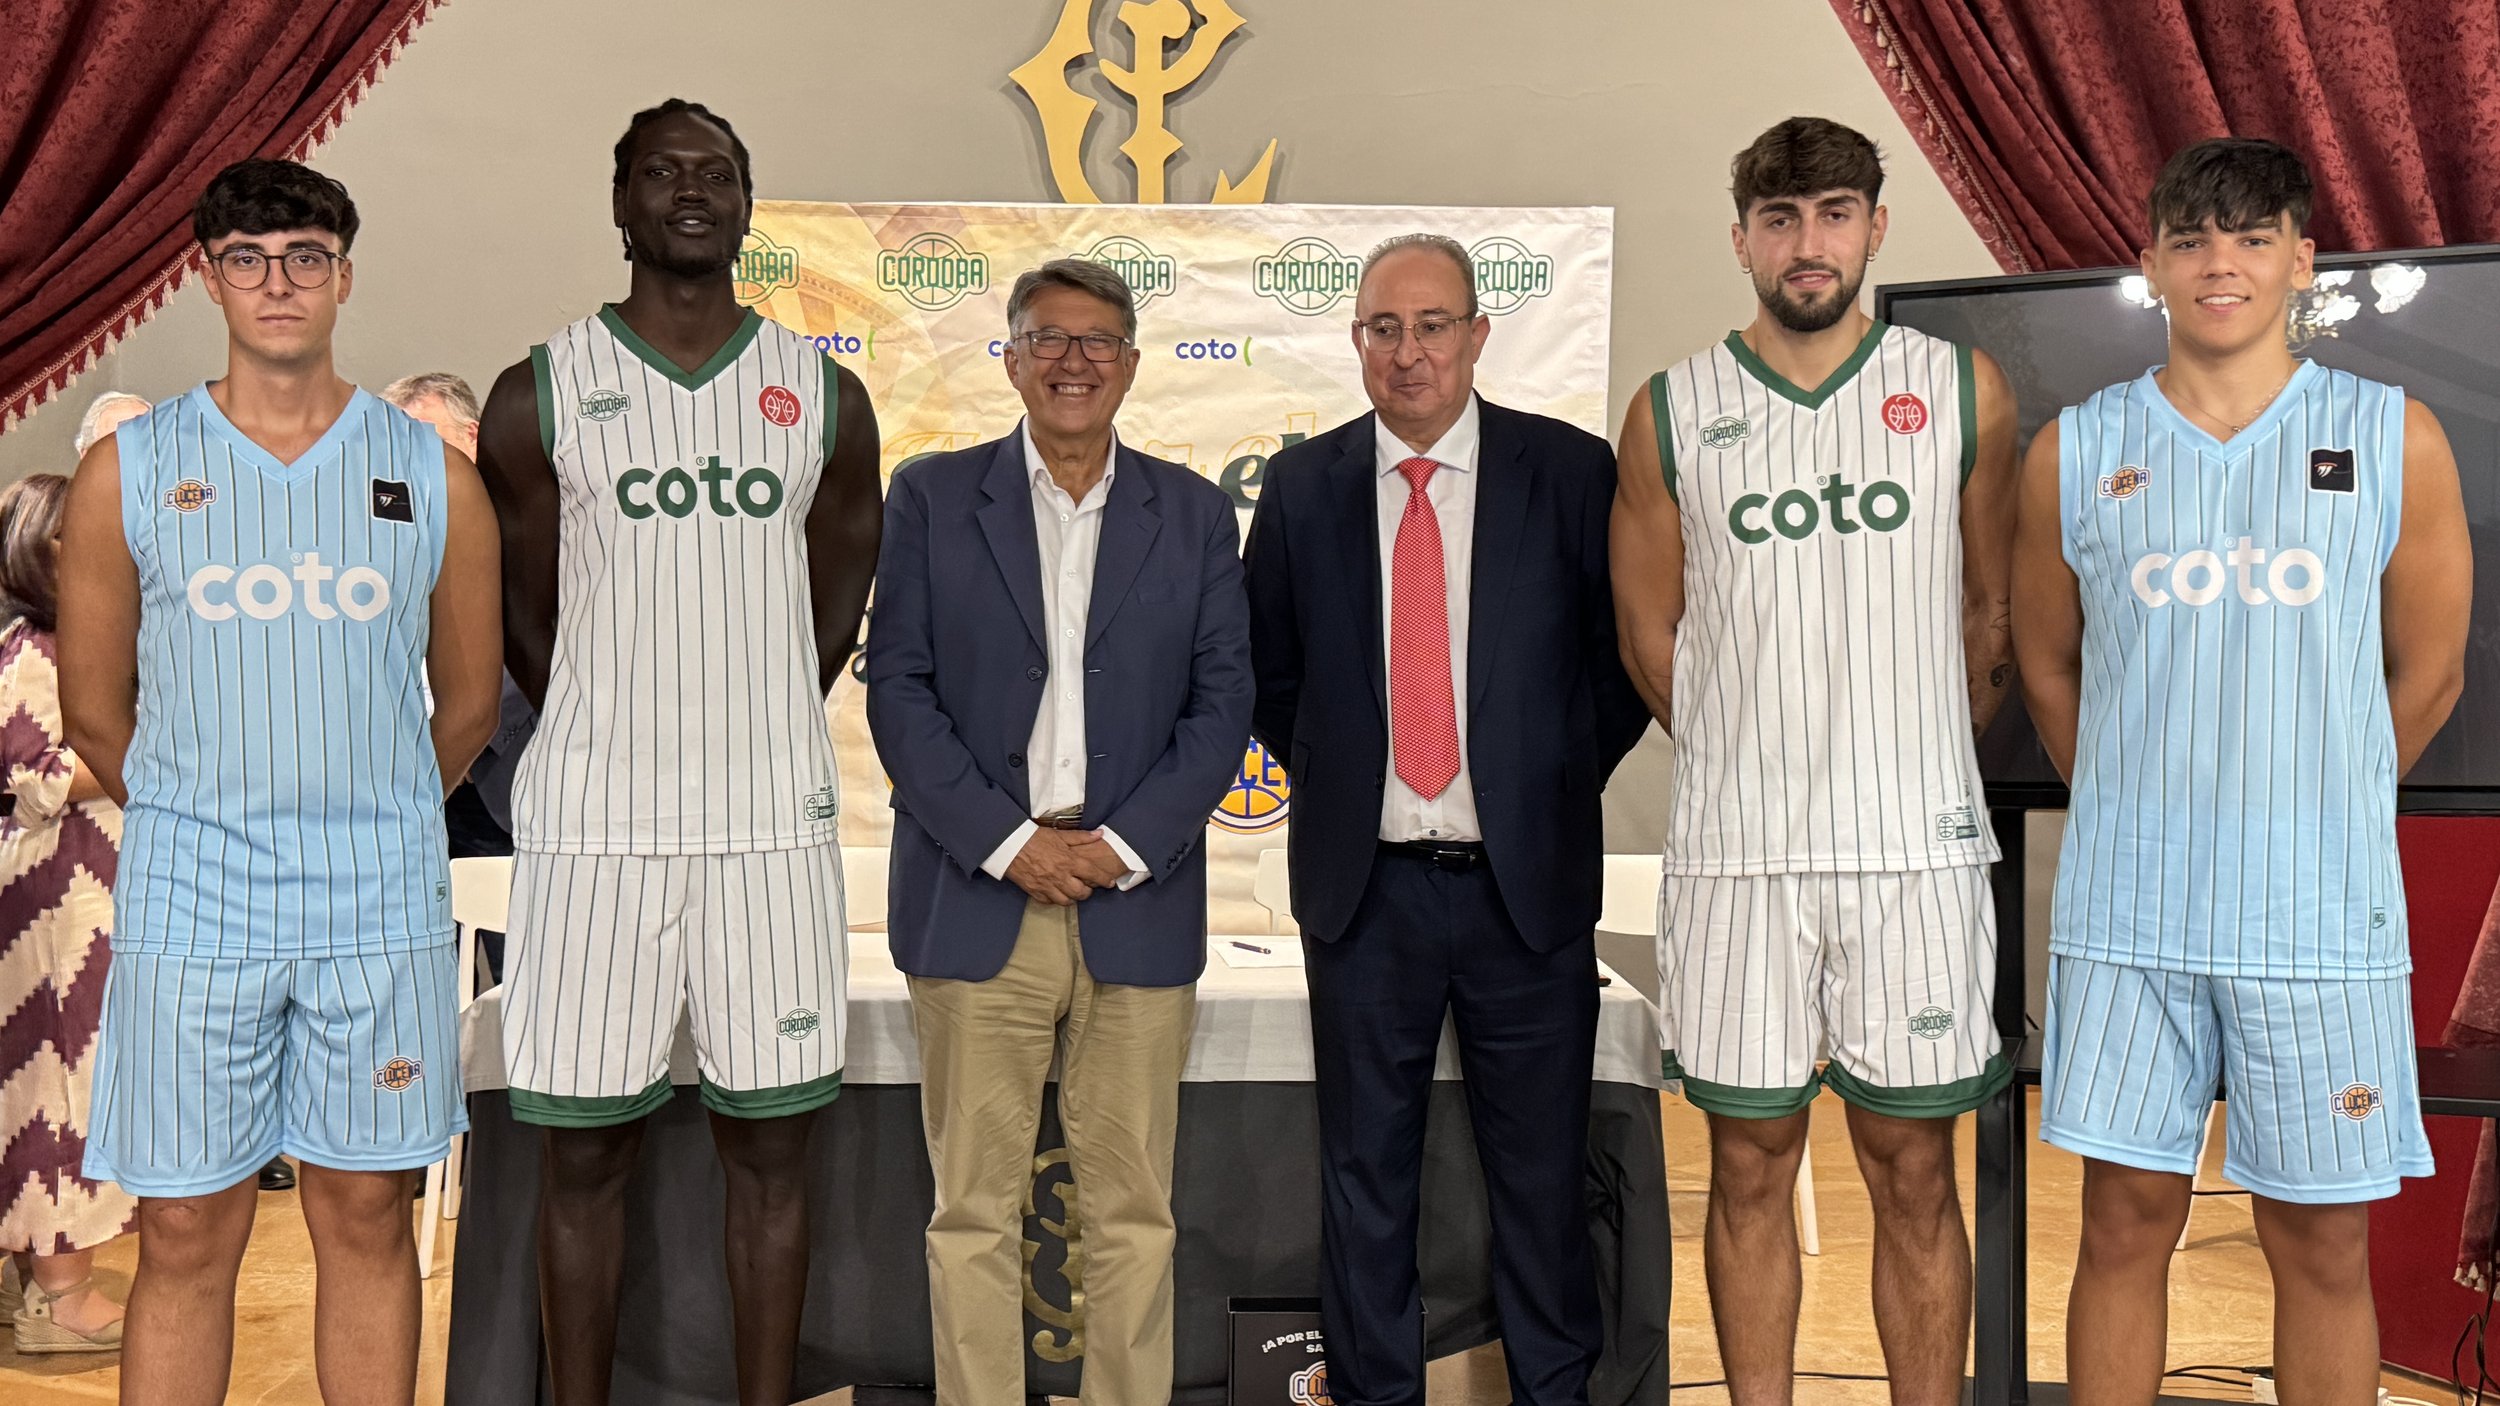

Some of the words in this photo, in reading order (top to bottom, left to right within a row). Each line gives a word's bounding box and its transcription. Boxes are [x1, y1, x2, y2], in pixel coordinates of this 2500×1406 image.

[737, 251, 793, 283] DOBA
[1101, 259, 1170, 291] DOBA
[1477, 261, 1548, 291] RDOBA
[1175, 338, 1237, 360] coto
[616, 456, 784, 520] coto
[1728, 472, 1911, 545] coto
[187, 551, 391, 622] coto
[2130, 535, 2325, 608] coto
[1276, 1332, 1305, 1346] POR
[1305, 1343, 1325, 1354] SA
